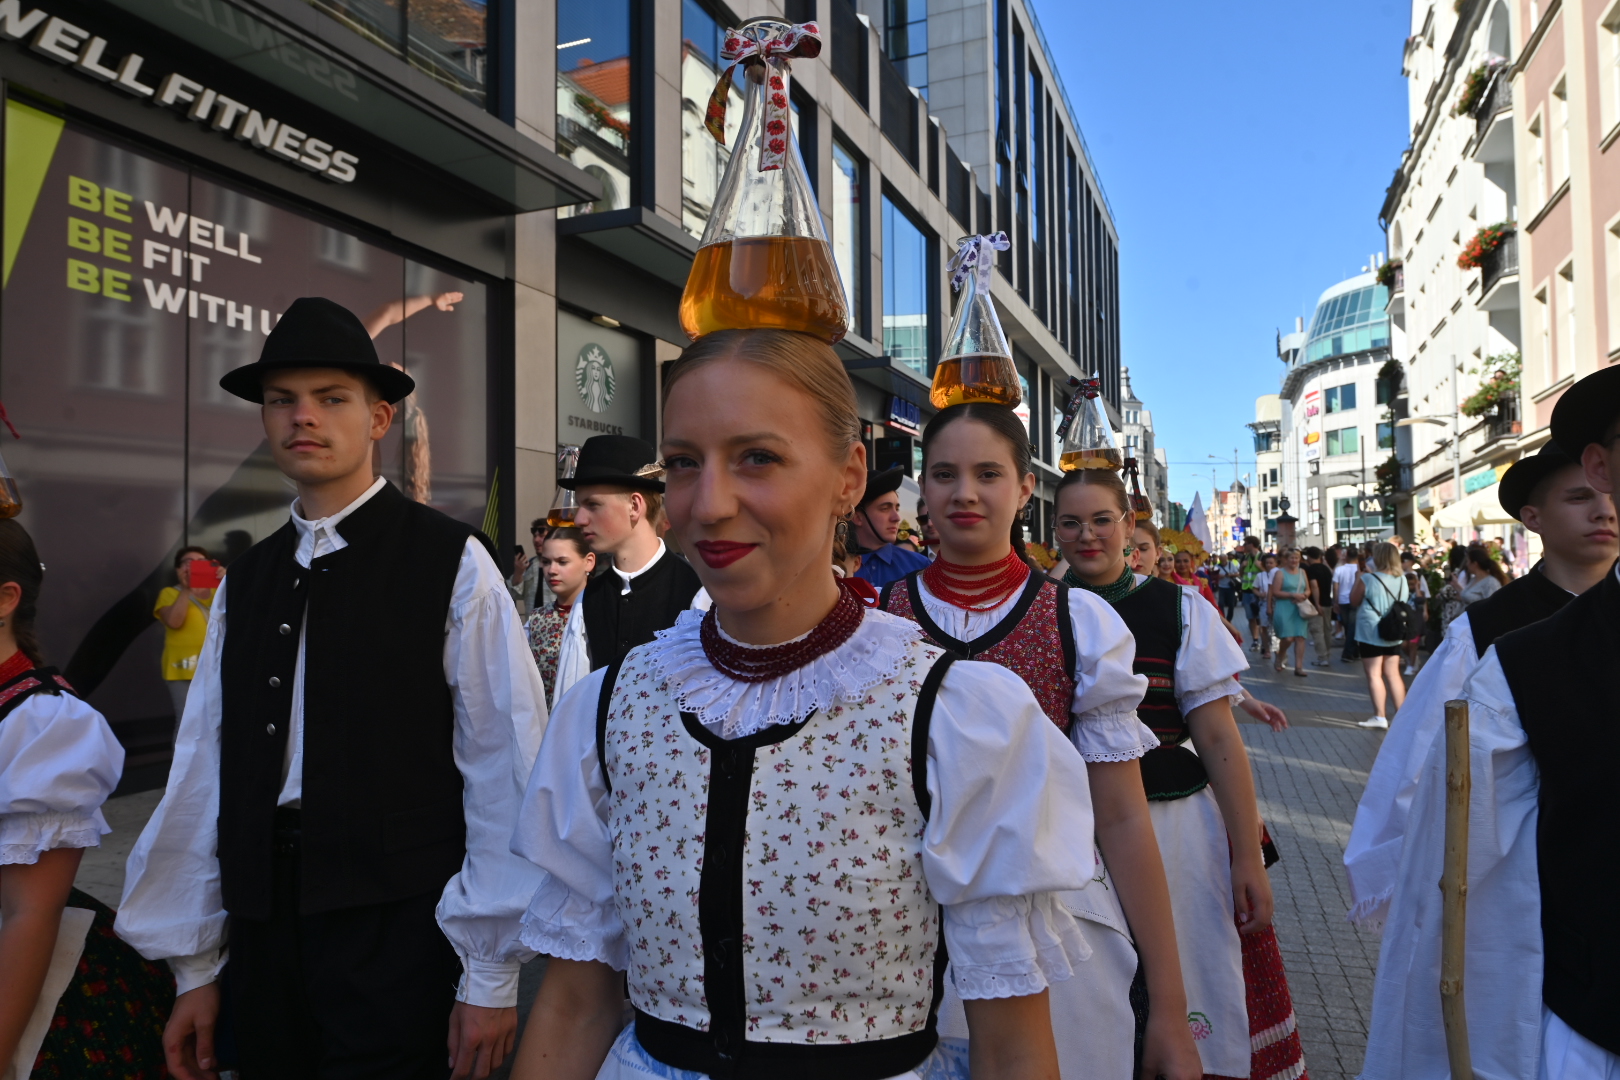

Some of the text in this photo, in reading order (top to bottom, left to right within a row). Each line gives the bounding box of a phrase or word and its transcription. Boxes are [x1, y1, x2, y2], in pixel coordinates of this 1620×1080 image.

[0, 0, 359, 182] WELL FITNESS
[67, 216, 210, 282] BE FIT
[68, 175, 262, 264] BE WELL
[66, 257, 283, 336] BE WITH U
[568, 415, 623, 436] STARBUCKS
[890, 395, 920, 430] ALDI
